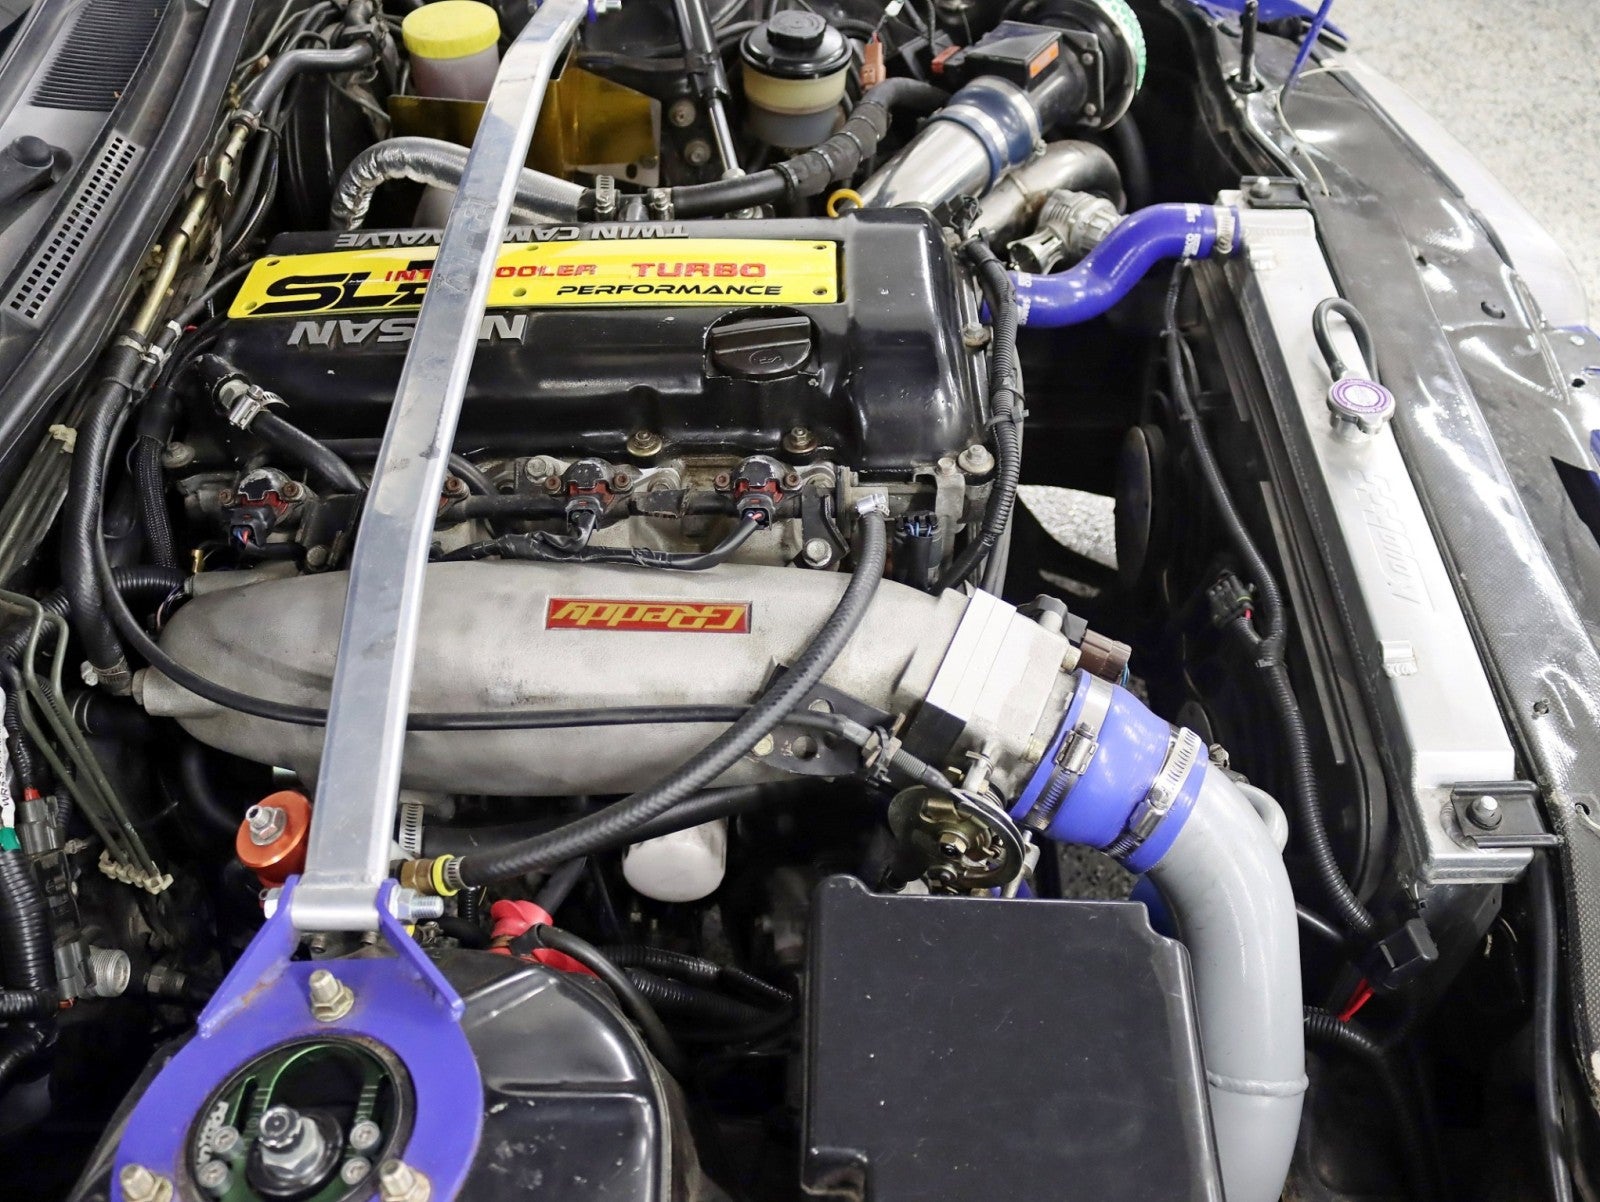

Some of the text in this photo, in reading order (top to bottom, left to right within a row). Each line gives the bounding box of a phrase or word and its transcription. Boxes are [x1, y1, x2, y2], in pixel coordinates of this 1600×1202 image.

[334, 223, 689, 247] TWIN CAM VALVE
[631, 262, 767, 278] TURBO
[556, 284, 784, 296] PERFORMANCE
[286, 313, 529, 346] NSAN
